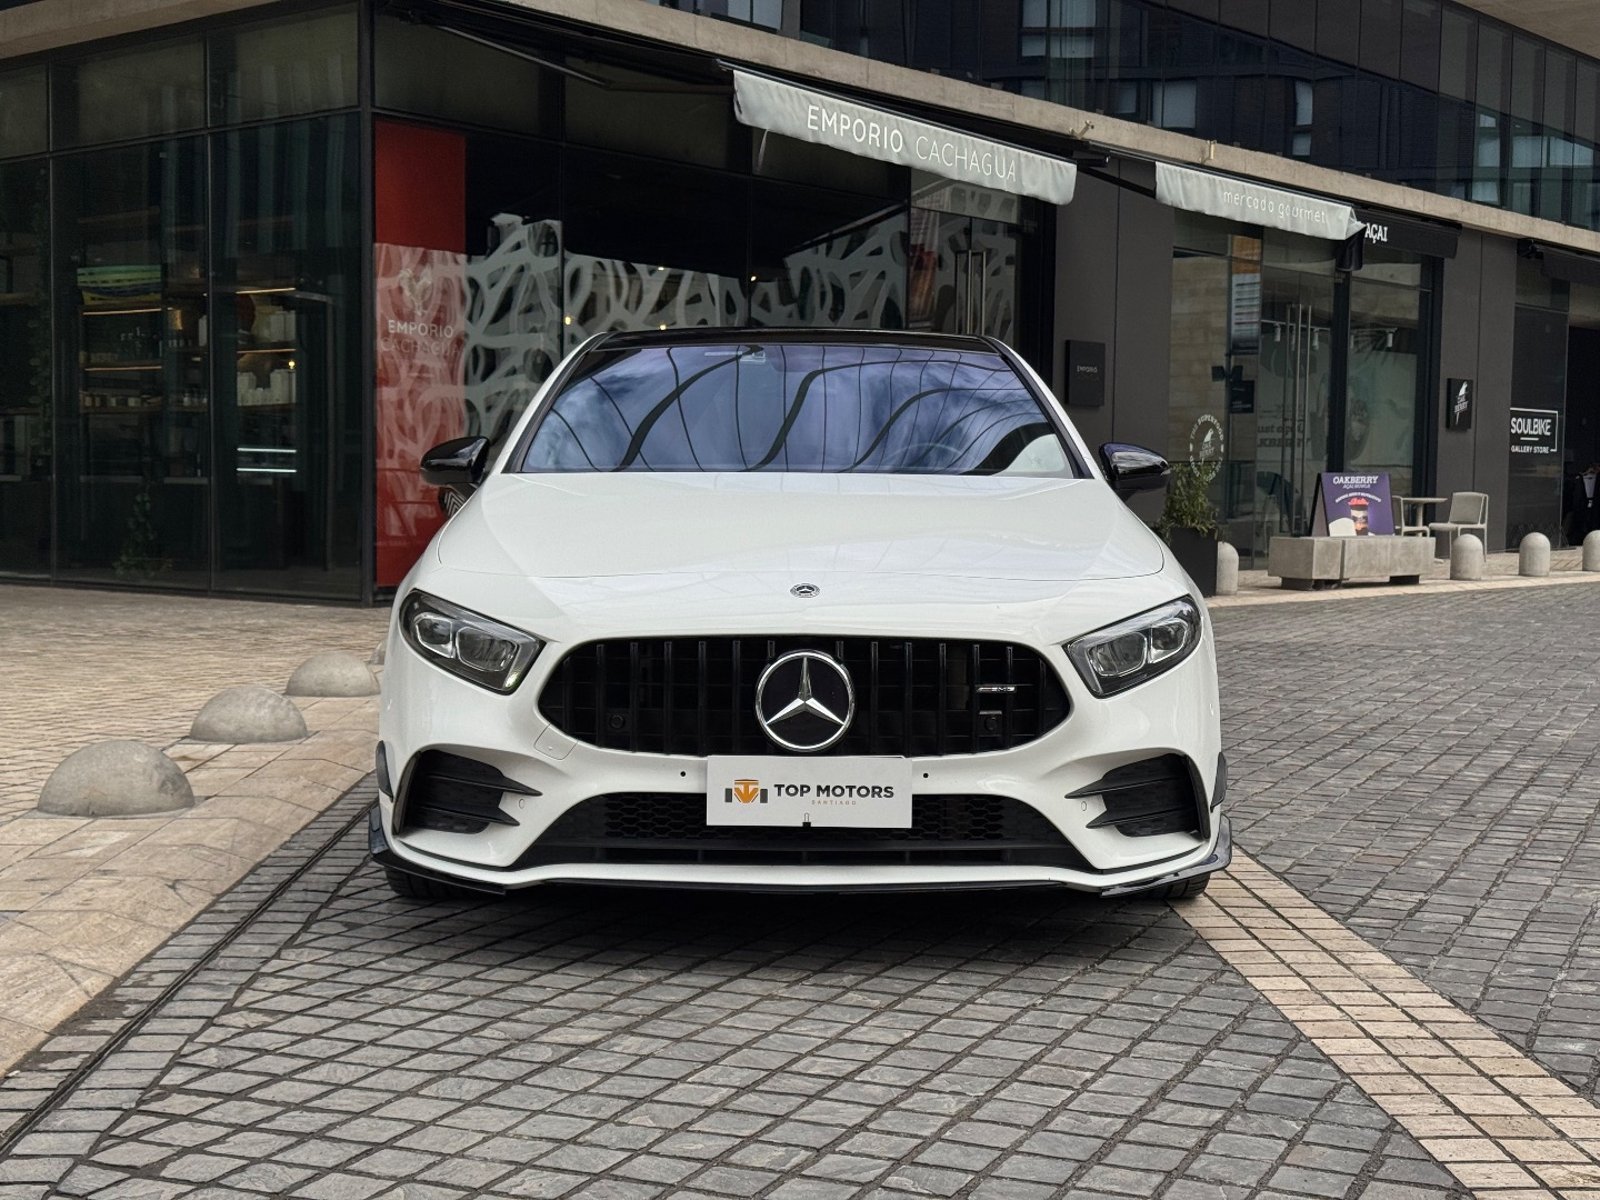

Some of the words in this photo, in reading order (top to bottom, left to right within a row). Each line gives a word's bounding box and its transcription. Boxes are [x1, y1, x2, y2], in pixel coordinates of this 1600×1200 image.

[808, 105, 903, 153] EMPORIO
[915, 136, 1017, 182] CACHAGUA
[1223, 191, 1274, 213] mercado
[1278, 203, 1326, 224] gourmet
[388, 319, 454, 338] EMPORIO
[1510, 417, 1552, 436] SOULBIKE
[1510, 445, 1533, 453] GALLERY
[1533, 446, 1550, 454] STORE
[1332, 475, 1379, 485] OAKBERRY
[774, 784, 811, 797] TOP
[816, 785, 895, 799] MOTORS
